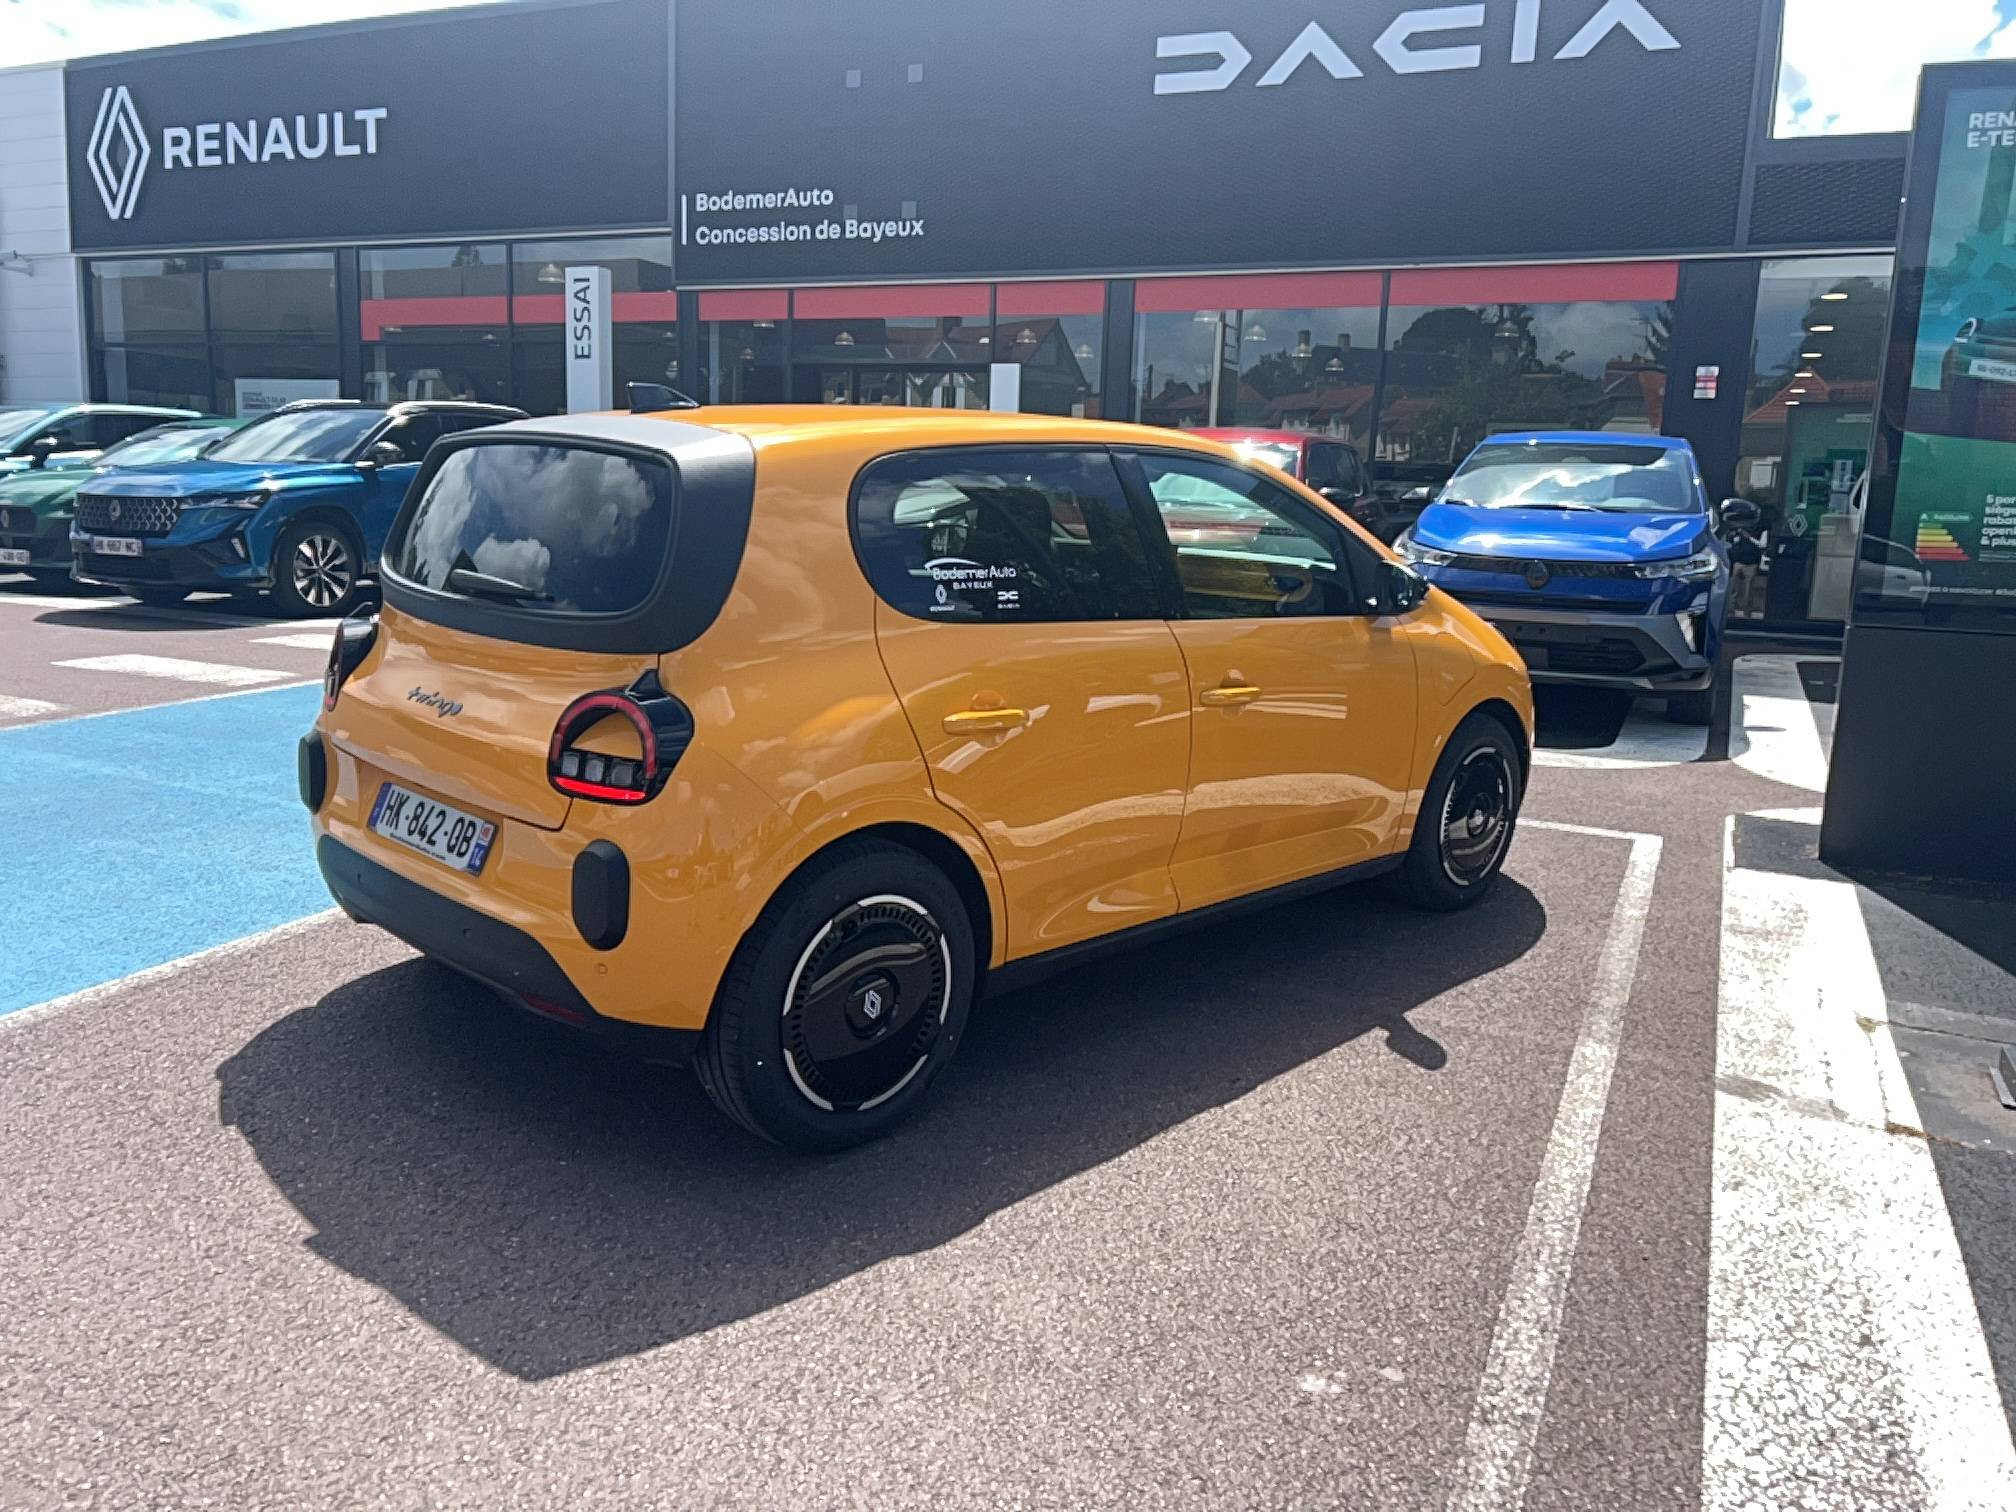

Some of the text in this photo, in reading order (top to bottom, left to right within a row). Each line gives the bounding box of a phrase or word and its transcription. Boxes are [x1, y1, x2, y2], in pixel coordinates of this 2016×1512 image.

[1153, 0, 1682, 95] DACIA
[1969, 110, 2016, 129] REN
[163, 107, 388, 170] RENAULT
[1967, 129, 2016, 148] E-TE
[695, 187, 834, 212] BodemerAuto
[695, 218, 924, 245] Concession de Bayeux
[573, 277, 592, 360] ESSAI
